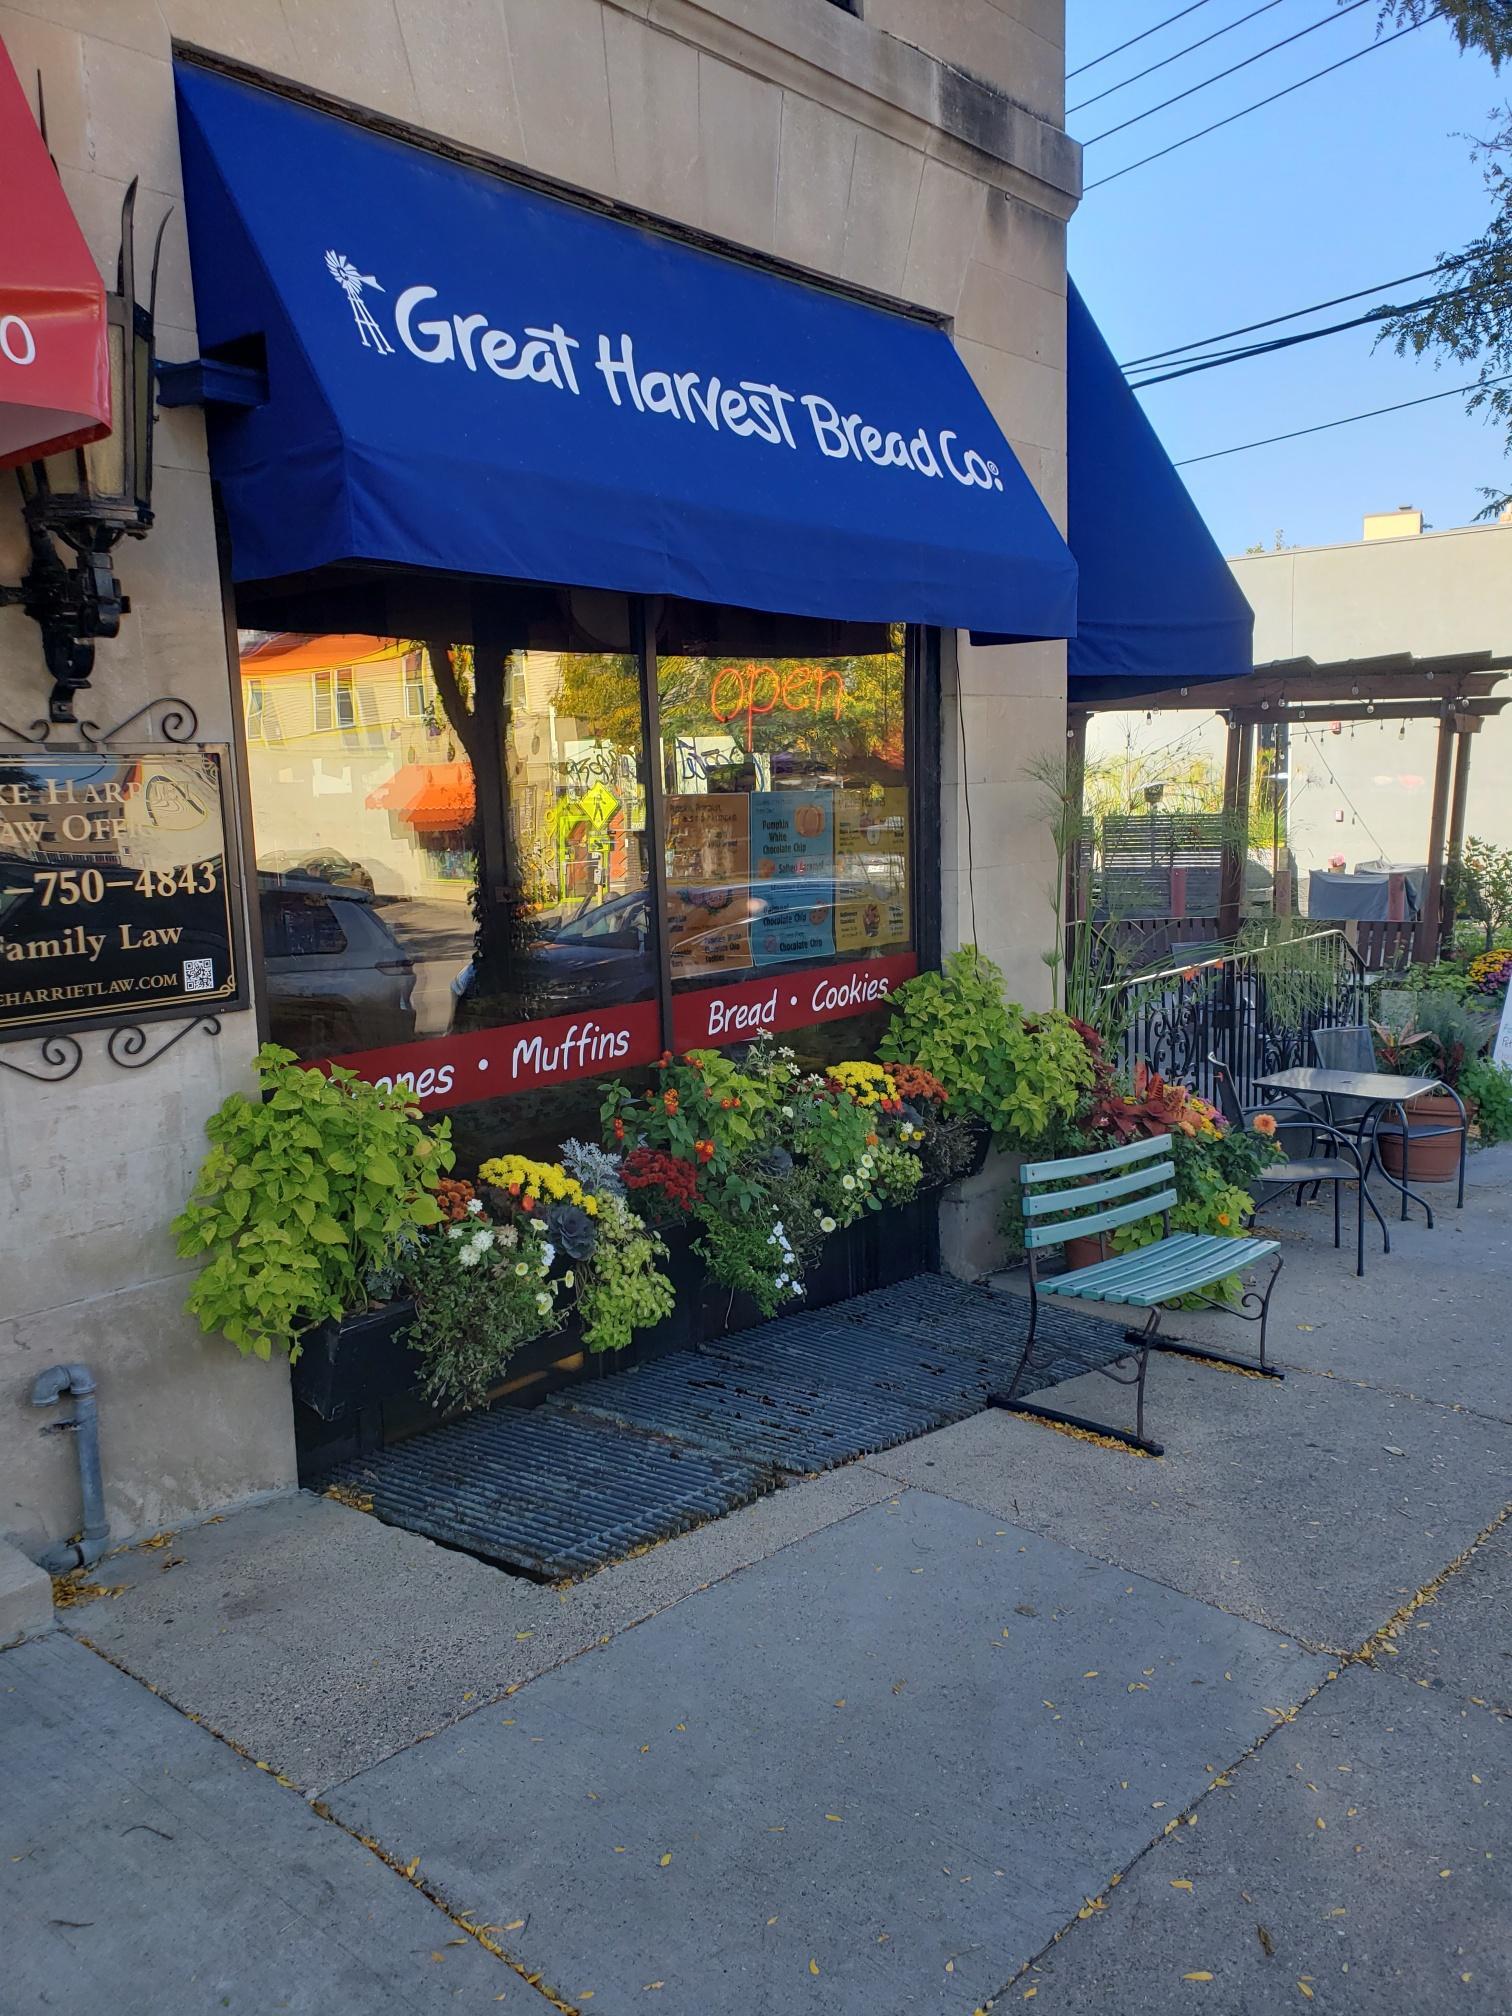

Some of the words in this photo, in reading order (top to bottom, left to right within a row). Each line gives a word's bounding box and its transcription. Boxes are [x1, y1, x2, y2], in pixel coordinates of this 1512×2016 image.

[395, 286, 581, 395] Great
[595, 333, 797, 450] Harvest
[800, 394, 944, 479] Bread
[710, 663, 846, 753] open
[768, 831, 787, 842] White
[118, 923, 184, 951] Law
[779, 940, 808, 952] Chocolate
[809, 937, 823, 948] Chip
[708, 988, 778, 1036] Bread
[811, 973, 889, 1012] Cookies
[512, 1022, 630, 1079] Muffins
